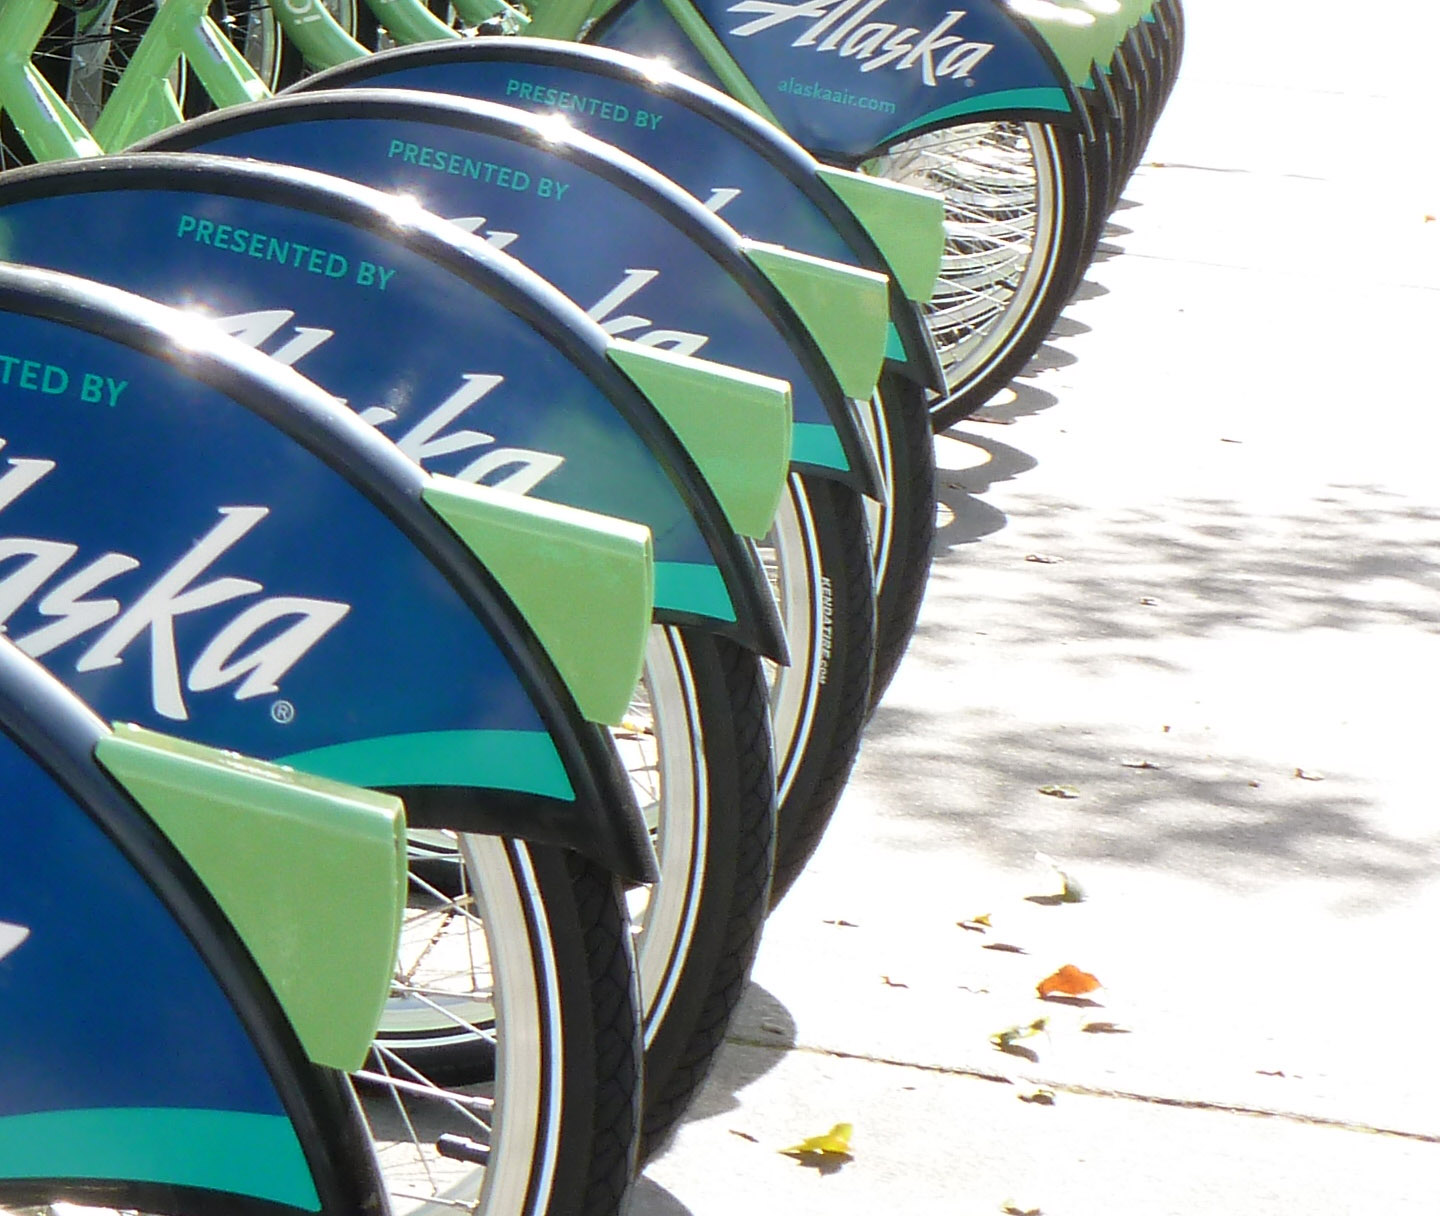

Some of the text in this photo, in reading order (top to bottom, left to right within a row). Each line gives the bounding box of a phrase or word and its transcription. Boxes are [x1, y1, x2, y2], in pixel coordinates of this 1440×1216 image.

[506, 79, 664, 131] PRESENTED BY
[777, 77, 897, 115] alaskaair.com
[387, 139, 569, 201] PRESENTED BY
[177, 215, 397, 292] PRESENTED BY
[80, 371, 130, 409] BY
